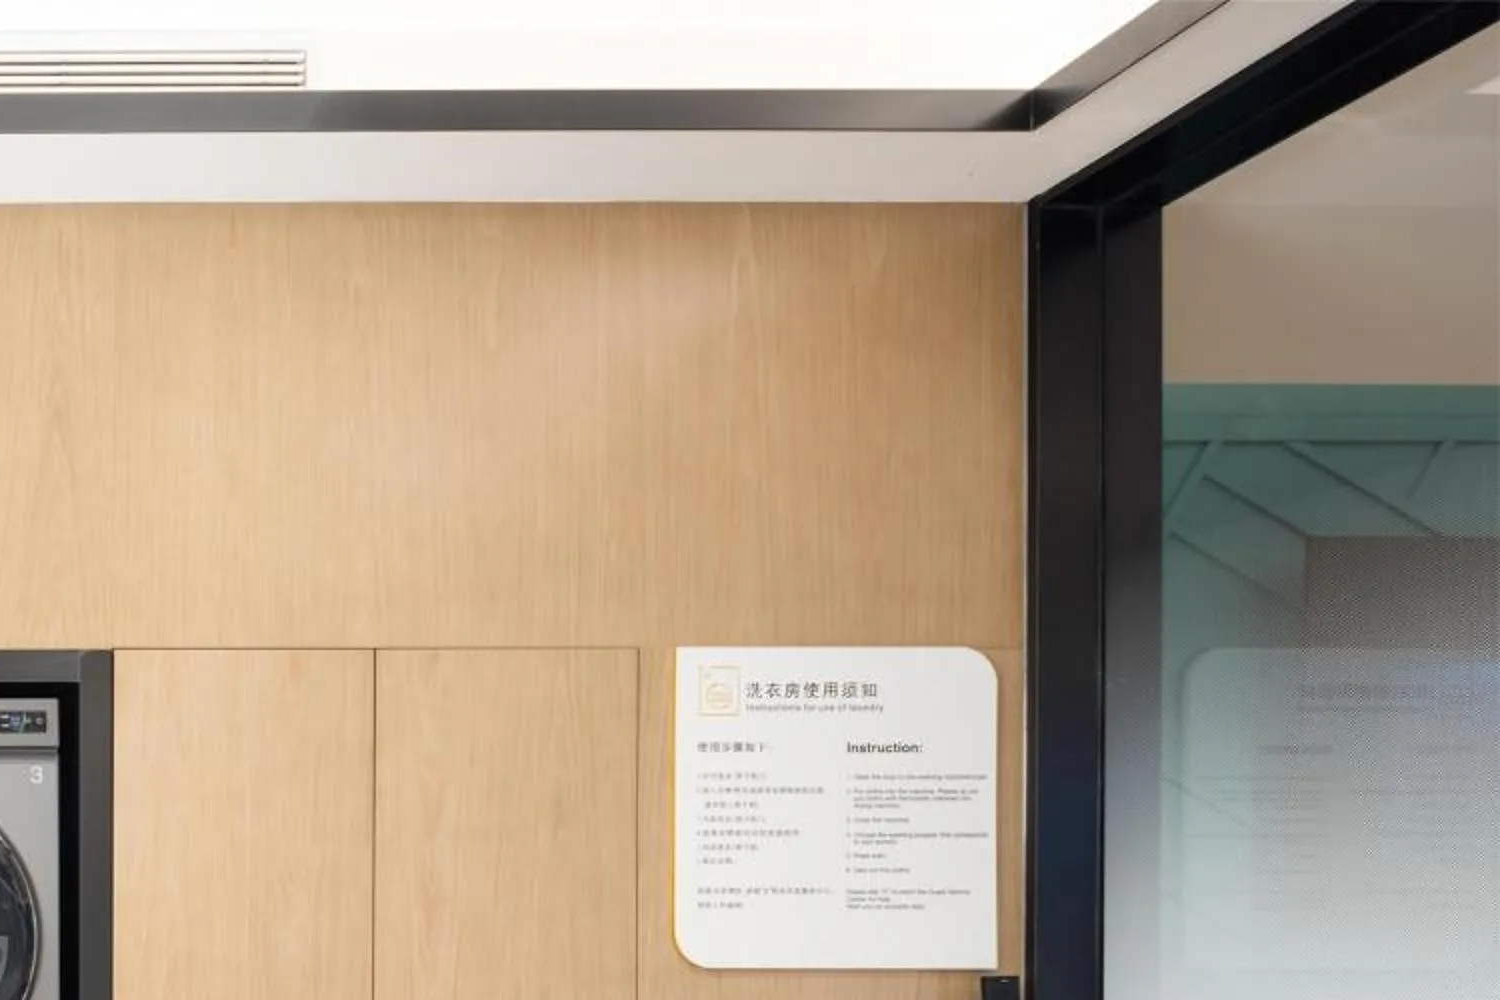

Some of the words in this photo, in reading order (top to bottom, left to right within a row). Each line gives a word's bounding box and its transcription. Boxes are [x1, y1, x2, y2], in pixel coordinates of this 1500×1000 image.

[746, 682, 877, 698] 洗衣房使用须知
[846, 742, 923, 753] Instruction:
[29, 766, 43, 784] 3
